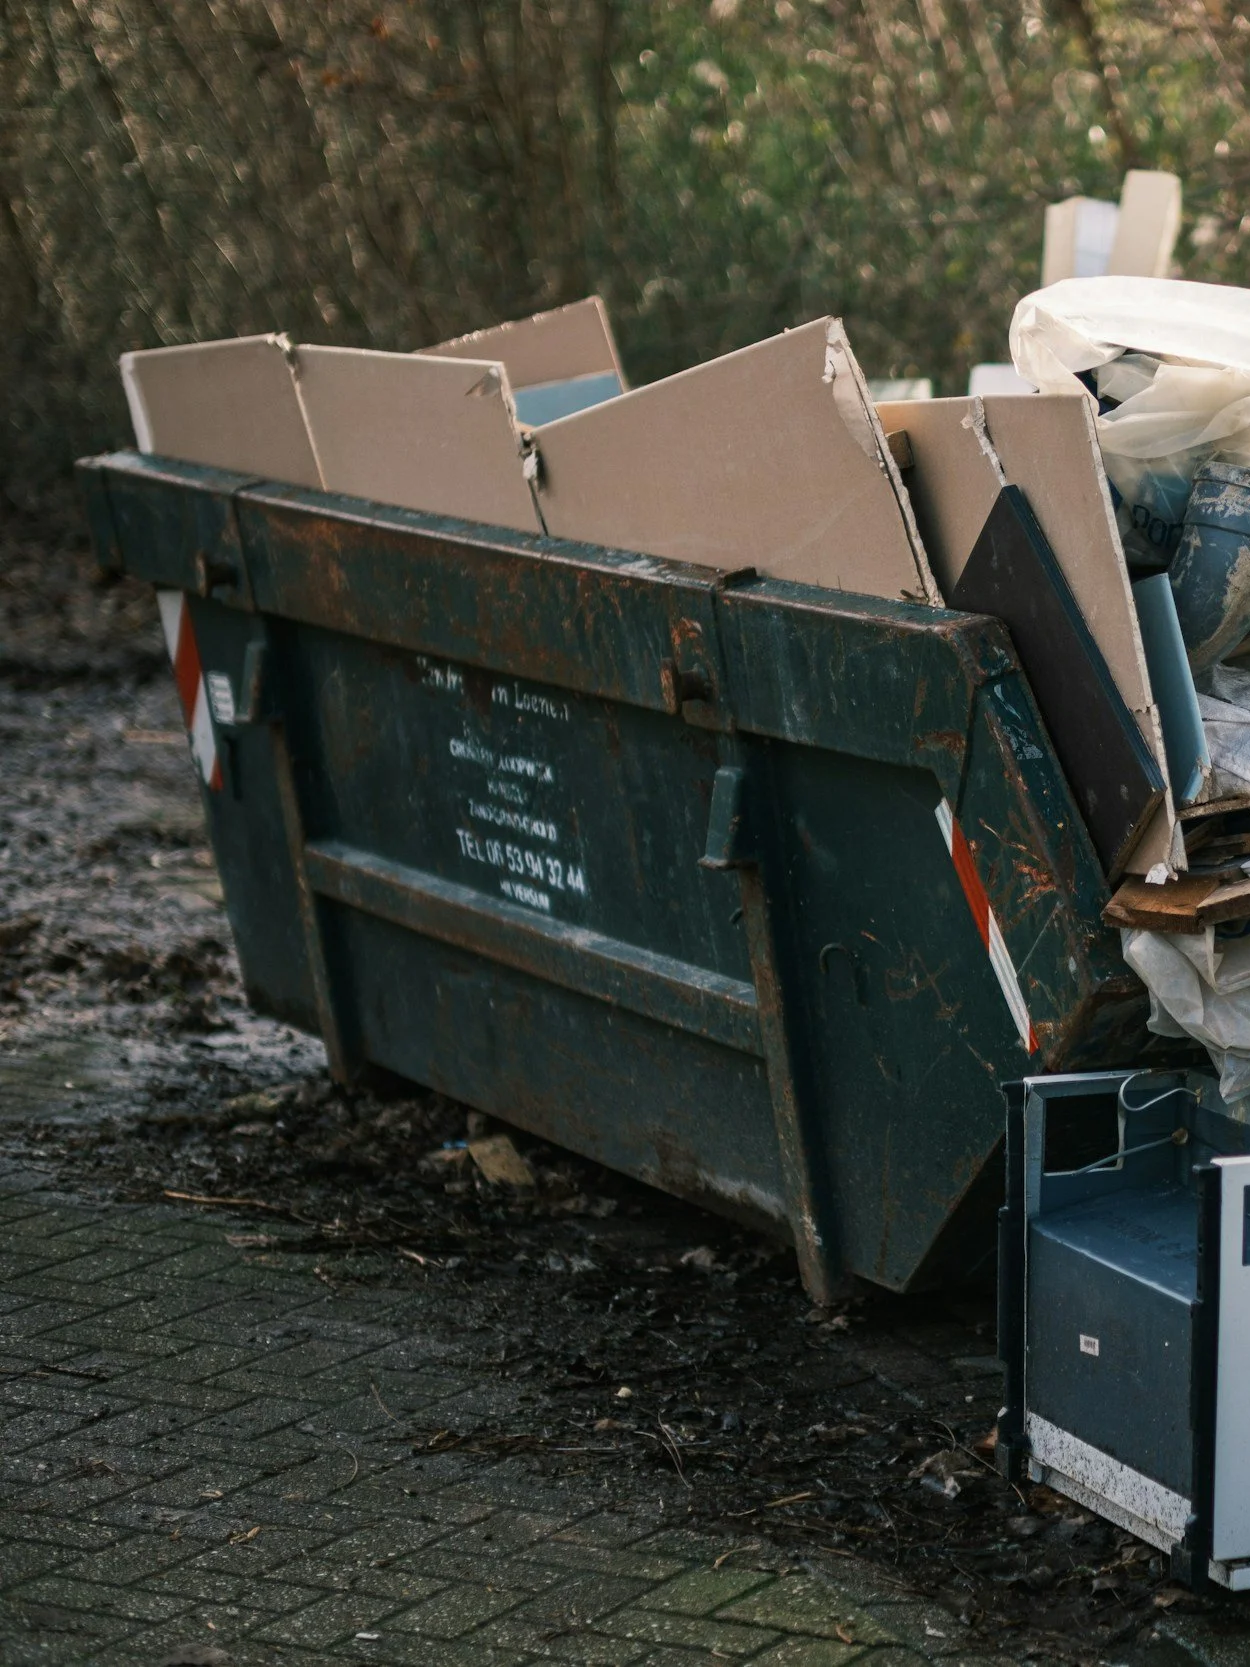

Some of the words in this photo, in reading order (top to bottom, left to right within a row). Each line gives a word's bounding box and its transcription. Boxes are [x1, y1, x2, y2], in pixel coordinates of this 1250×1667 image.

[456, 828, 485, 861] TEL
[506, 843, 524, 874] 53
[525, 850, 544, 880] 94
[546, 857, 565, 890] 32
[567, 864, 585, 894] 44
